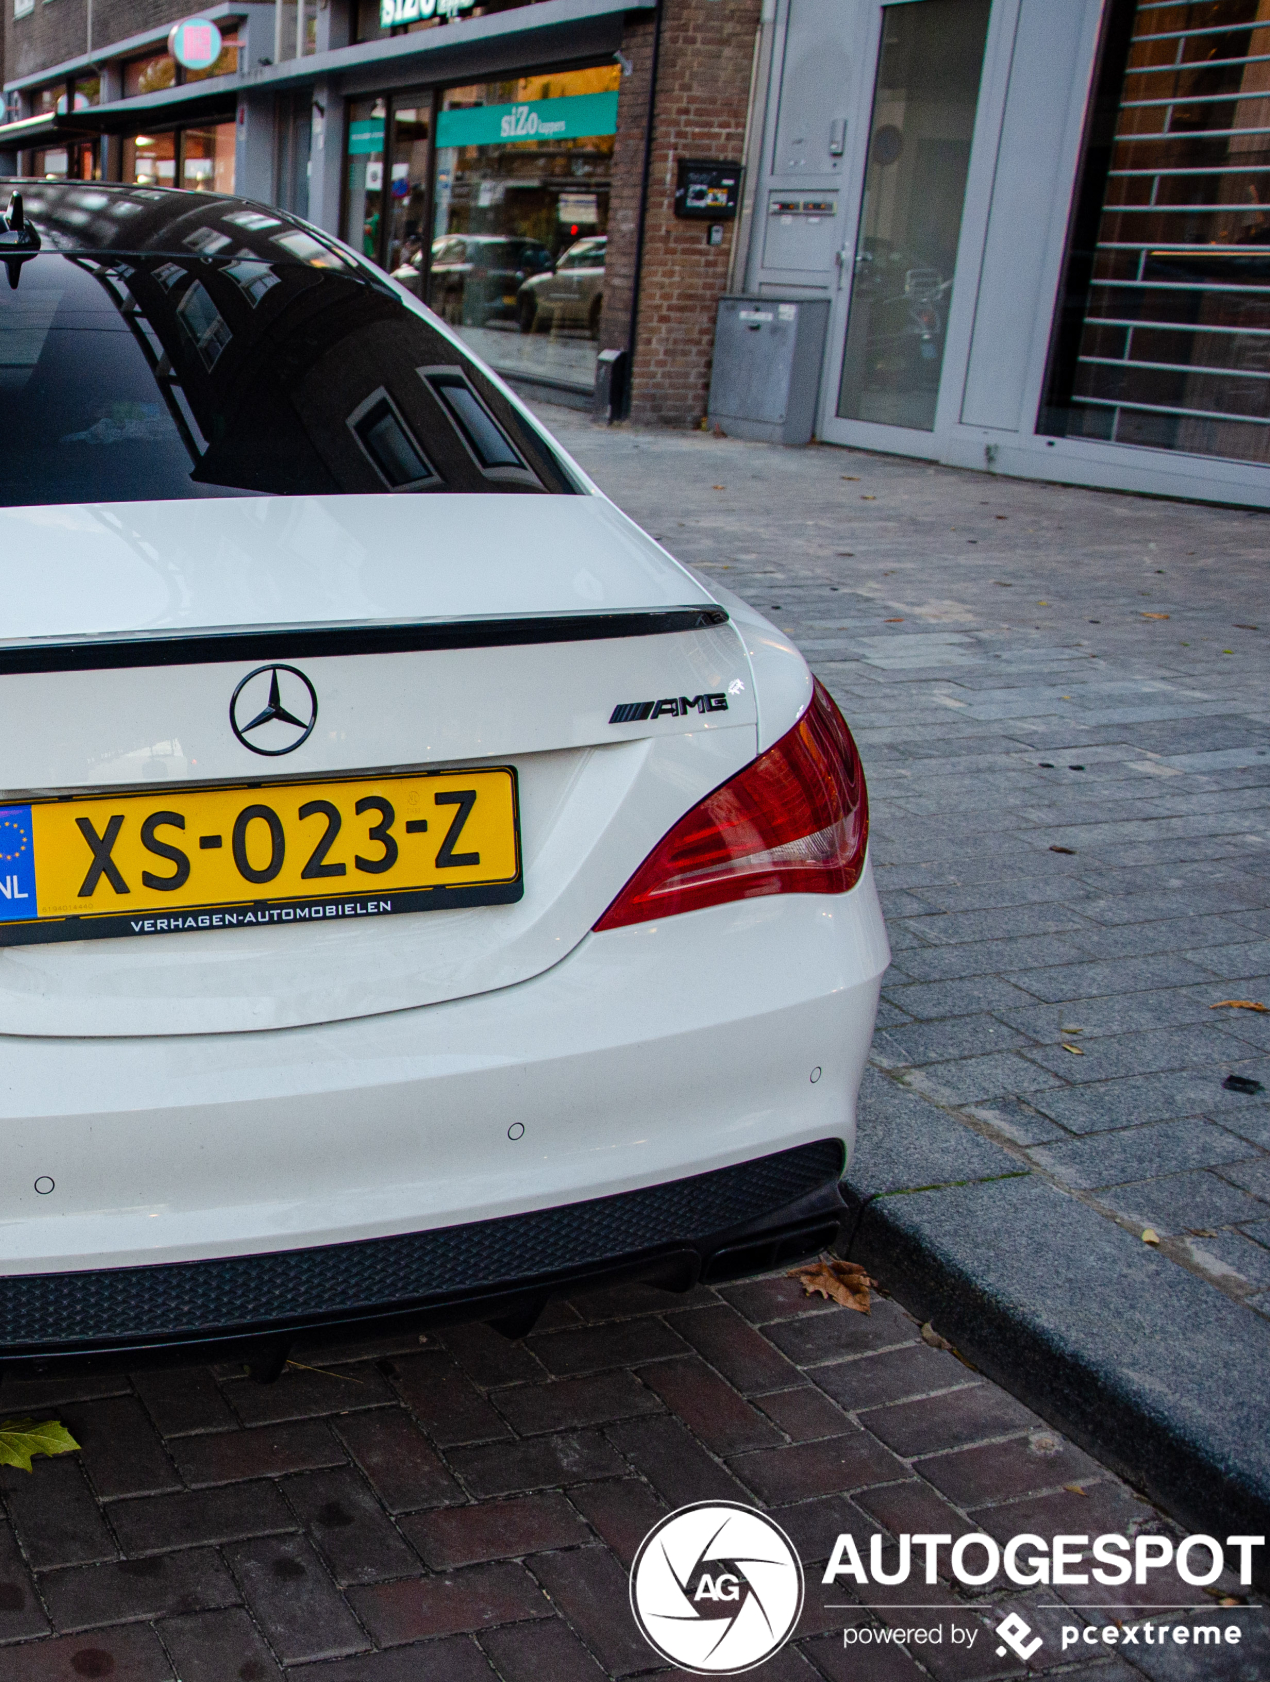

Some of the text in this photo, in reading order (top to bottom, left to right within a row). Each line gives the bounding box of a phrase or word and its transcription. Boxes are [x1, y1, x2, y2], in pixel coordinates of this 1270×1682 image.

[649, 692, 729, 720] AMG
[74, 789, 480, 897] XS-023-Z
[131, 901, 392, 932] VERHAGEN-AUTOMOBIELEN
